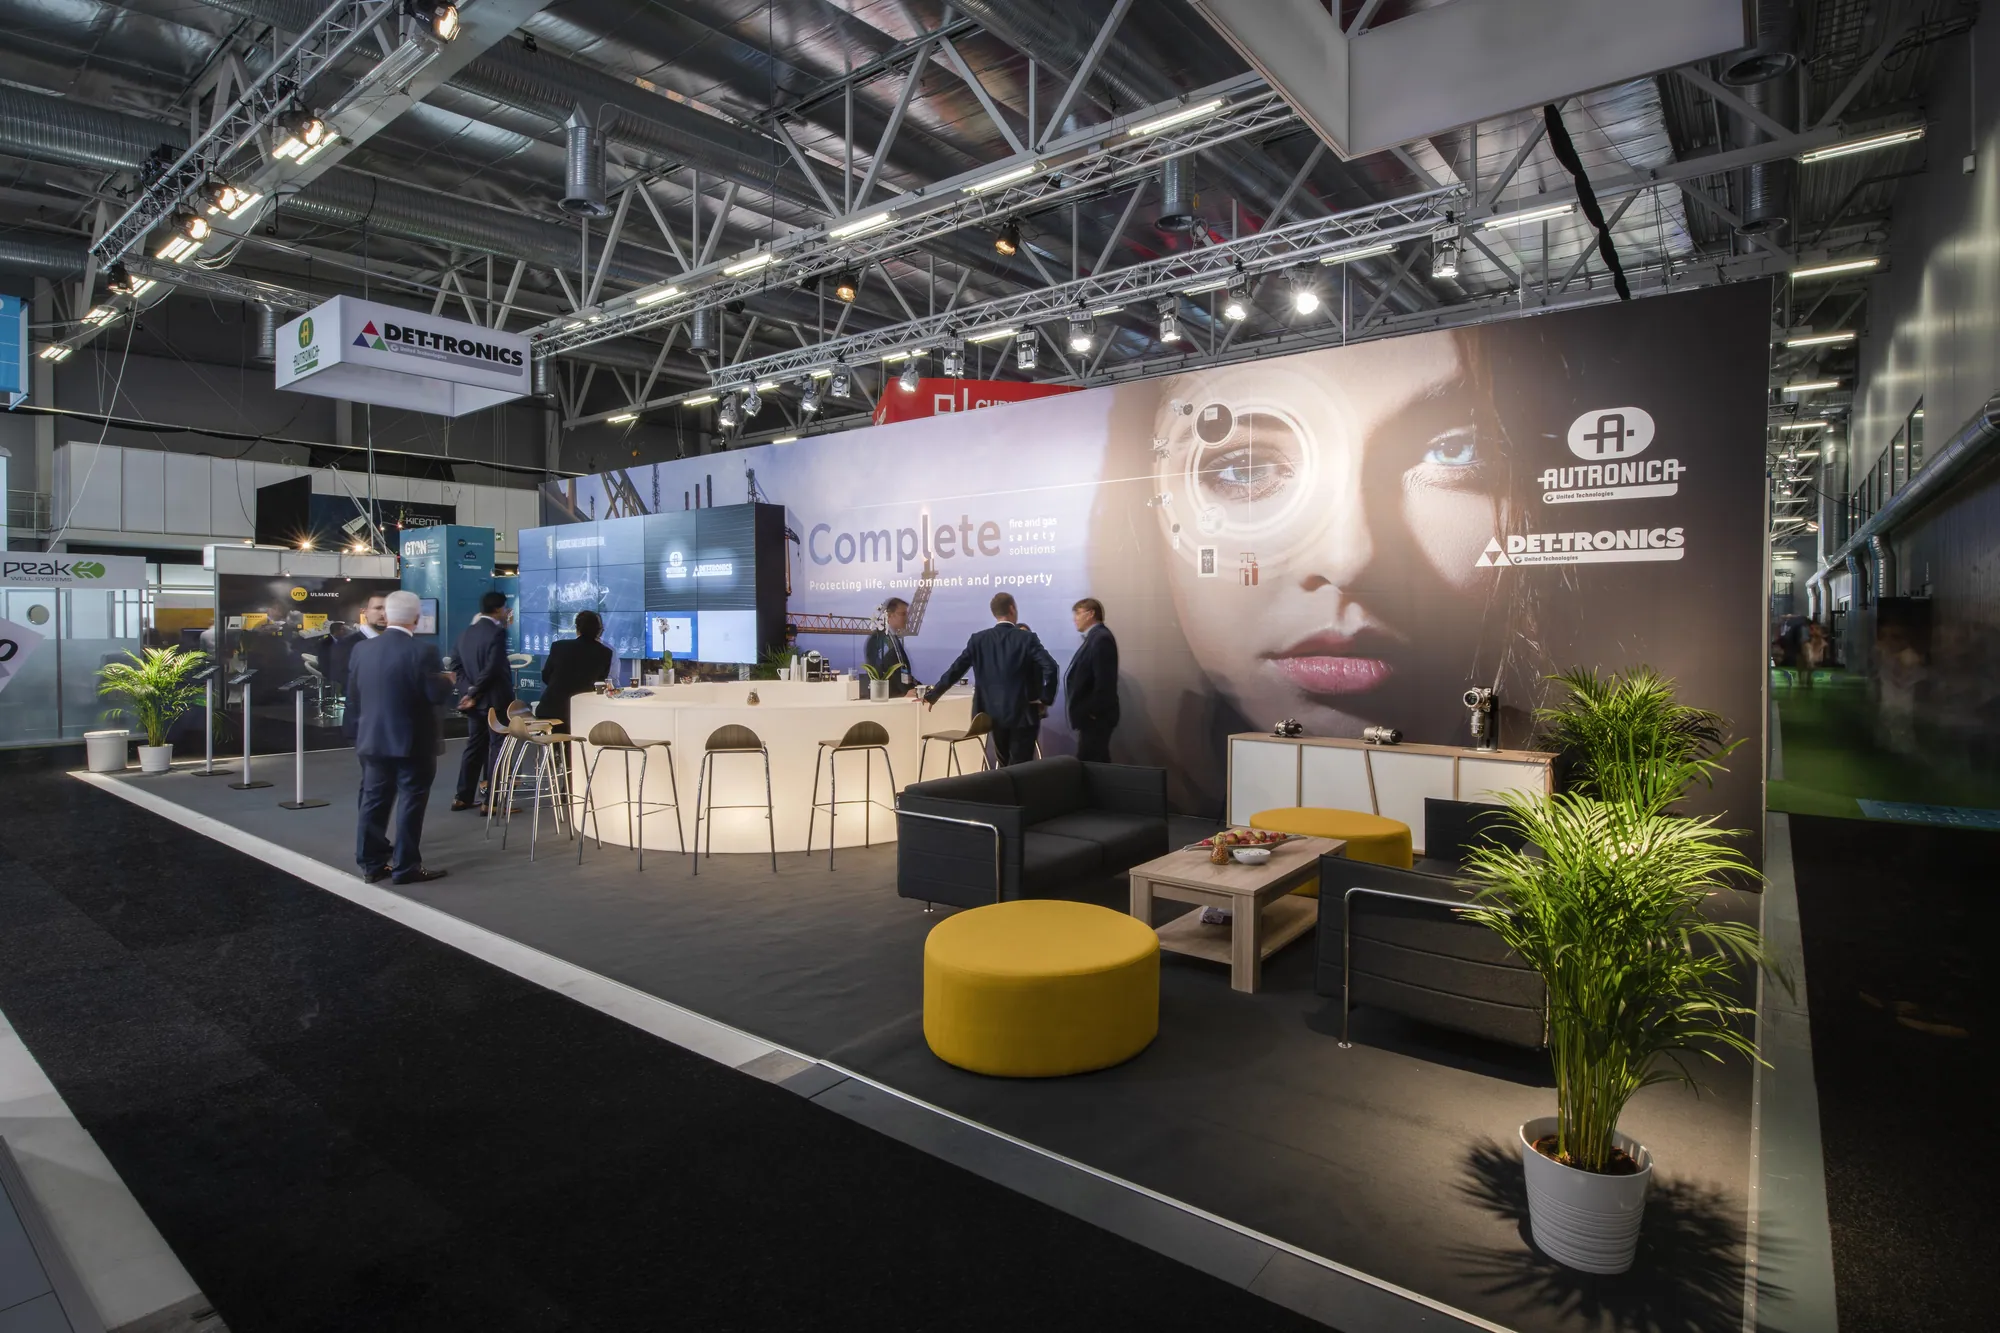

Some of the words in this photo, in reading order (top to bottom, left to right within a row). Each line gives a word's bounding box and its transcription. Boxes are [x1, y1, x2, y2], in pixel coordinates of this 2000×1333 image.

[384, 322, 523, 366] DET-TRONICS
[1537, 458, 1686, 490] AUTRONICA
[1576, 491, 1614, 499] Technologies
[1009, 518, 1023, 529] fire
[1025, 517, 1040, 528] and
[1042, 517, 1057, 529] gas
[808, 514, 1001, 573] Complete
[1009, 531, 1056, 541] safety
[1507, 527, 1685, 553] DET-TRONICS
[1009, 545, 1056, 555] solutions
[4, 560, 70, 577] peak
[809, 578, 862, 592] Protecting
[865, 577, 886, 590] life,
[890, 575, 963, 588] environment
[968, 575, 990, 586] and
[994, 573, 1053, 588] property
